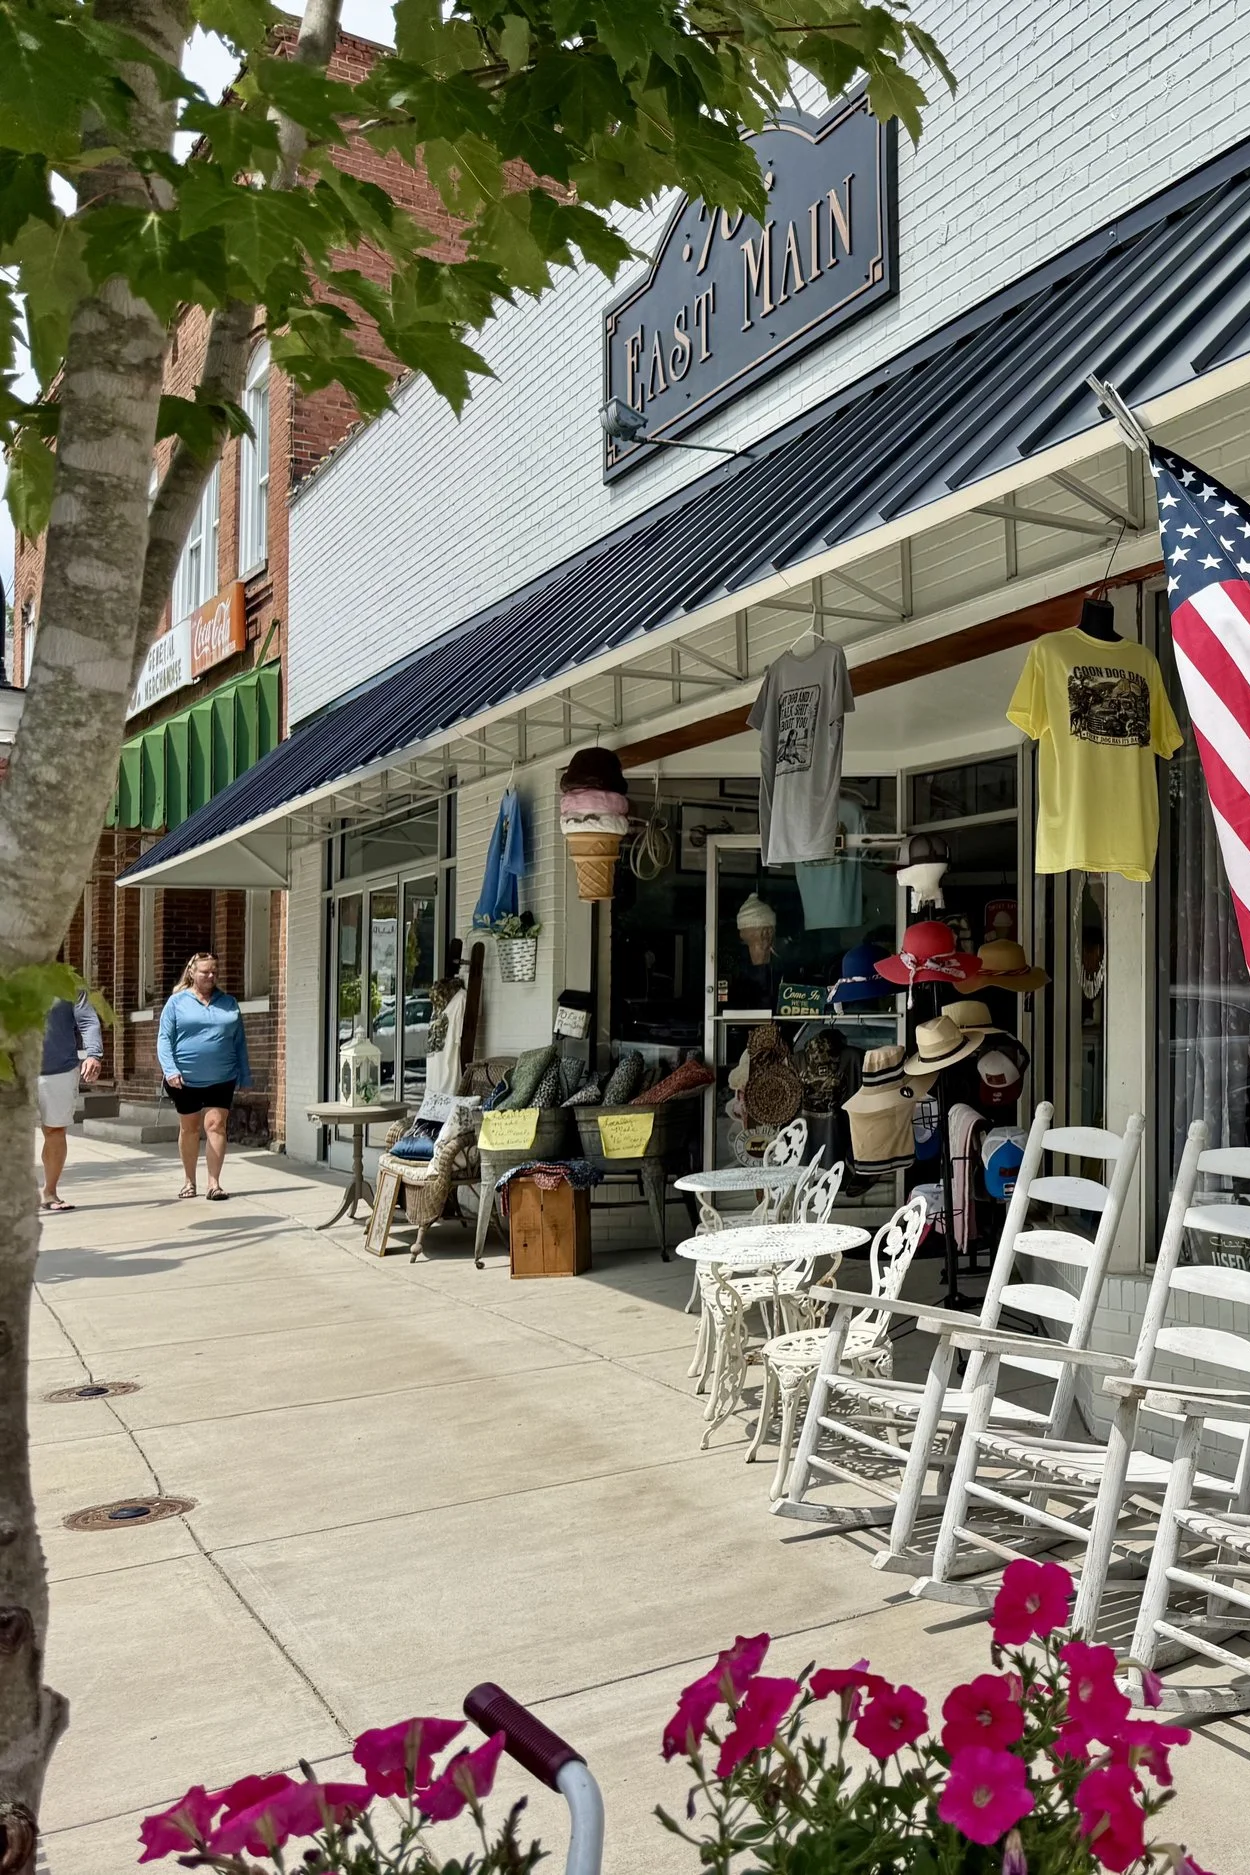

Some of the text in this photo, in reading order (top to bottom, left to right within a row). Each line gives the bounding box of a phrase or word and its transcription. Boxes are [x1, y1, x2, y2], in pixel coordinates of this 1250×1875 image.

[624, 172, 856, 413] EAST MAIN
[193, 598, 231, 660] Coca-Cola
[1073, 666, 1103, 680] COON
[1104, 668, 1127, 680] DOG
[782, 987, 821, 1001] Come In
[780, 1005, 819, 1016] OPEN
[1211, 1251, 1246, 1270] USED
